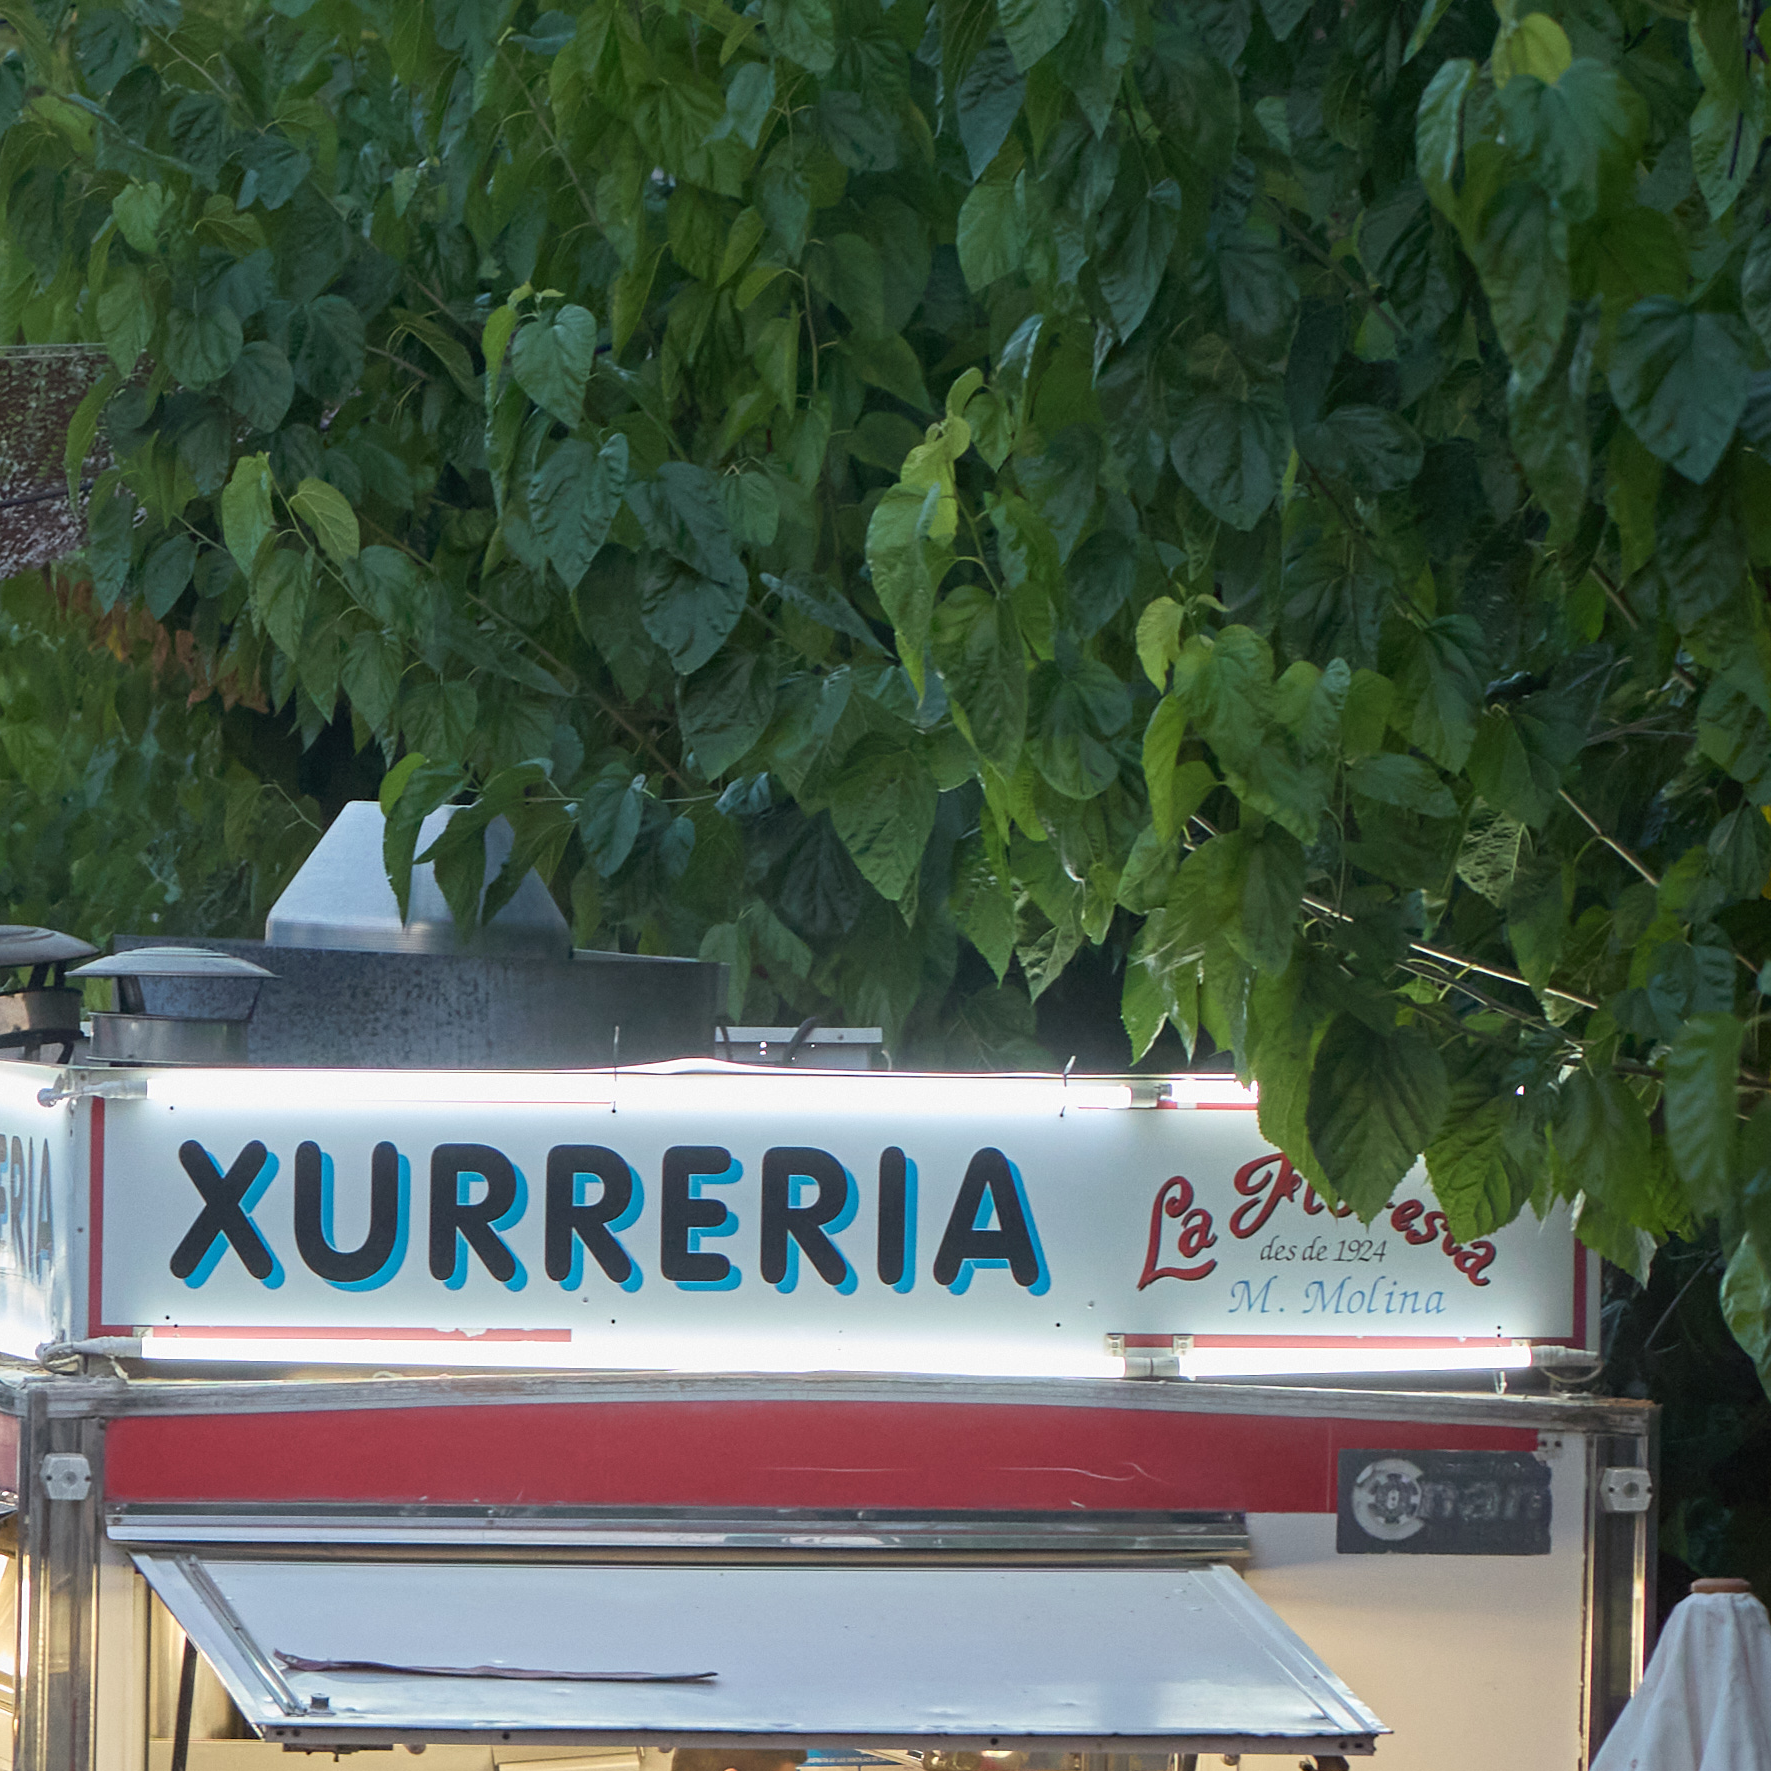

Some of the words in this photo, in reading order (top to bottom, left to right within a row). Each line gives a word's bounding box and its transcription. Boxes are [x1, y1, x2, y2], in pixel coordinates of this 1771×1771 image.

[170, 1138, 1051, 1297] XURRERIA
[1137, 1175, 1218, 1291] La
[1332, 1239, 1387, 1263] 1924
[1228, 1275, 1285, 1315] M.
[1302, 1276, 1447, 1315] Molina
